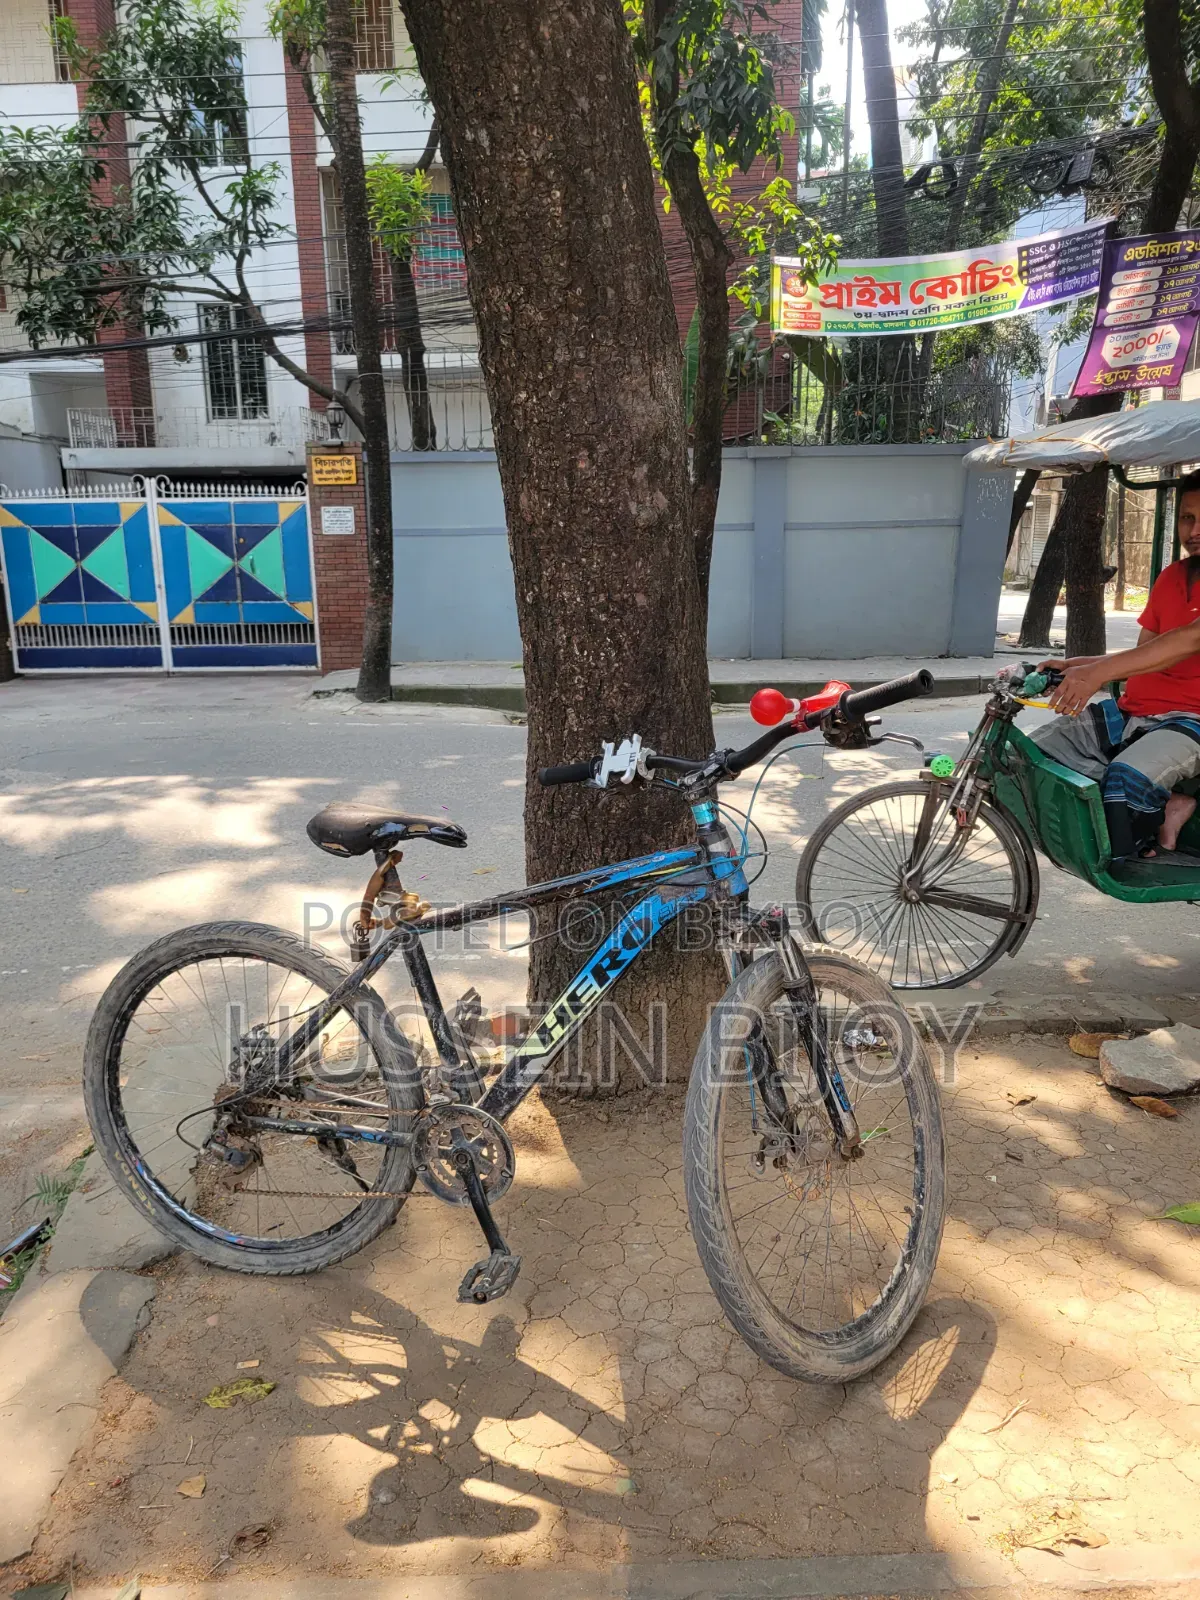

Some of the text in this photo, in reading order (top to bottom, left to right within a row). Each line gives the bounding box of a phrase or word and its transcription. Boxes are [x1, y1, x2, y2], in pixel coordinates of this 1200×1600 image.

[1029, 245, 1047, 256] SSC
[1123, 240, 1183, 262] এডমিশন
[818, 258, 1017, 310] প্রাইম কোচিং
[912, 303, 940, 316] শ্রেণি
[943, 298, 977, 311] সকল
[979, 291, 1009, 305] বিষয়
[1111, 328, 1172, 358] ২০০০/-
[314, 456, 353, 467] বিচারপতি
[536, 917, 655, 1050] HERO
[113, 1150, 157, 1216] KENDA
